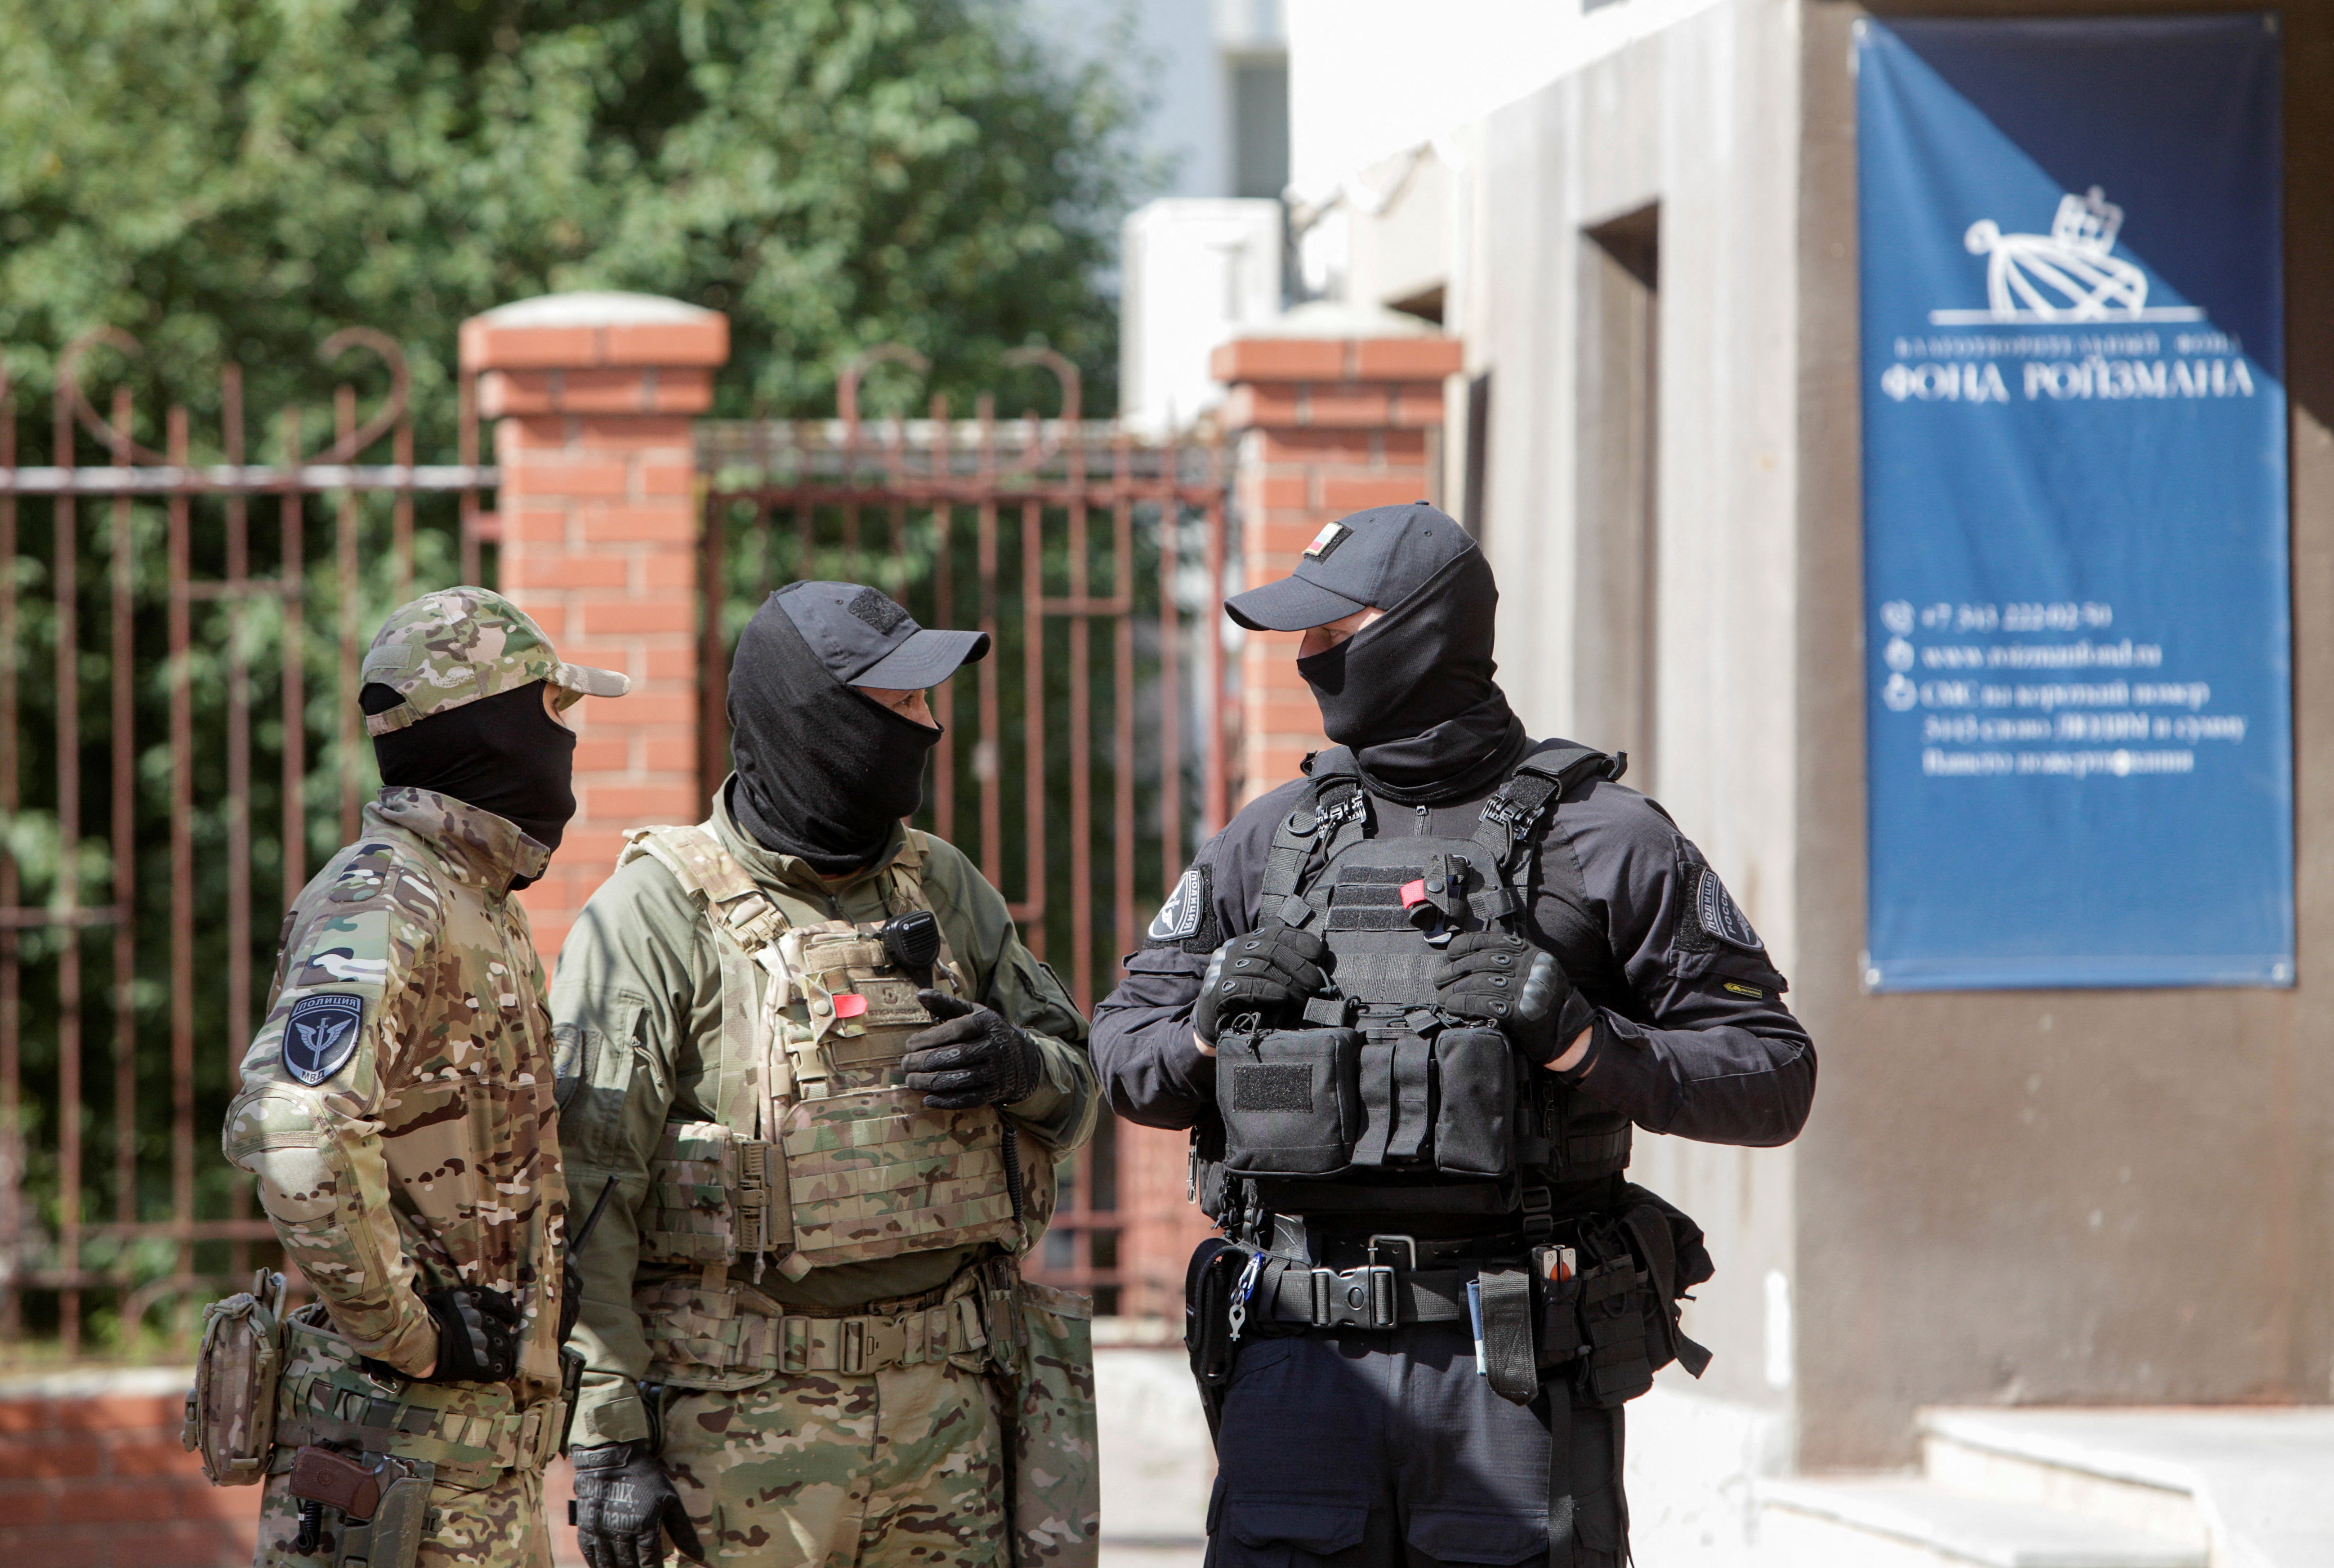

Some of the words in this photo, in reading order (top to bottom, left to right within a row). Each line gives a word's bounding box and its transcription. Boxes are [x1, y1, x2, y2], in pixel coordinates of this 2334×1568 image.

[1881, 361, 2010, 403] ФОНД
[1183, 874, 1197, 929] ПОЛИЦИЯ
[1704, 875, 1717, 930] ПОЛИЦИЯ
[299, 997, 356, 1011] ПОЛИЦИЯ
[301, 1069, 325, 1082] МВД
